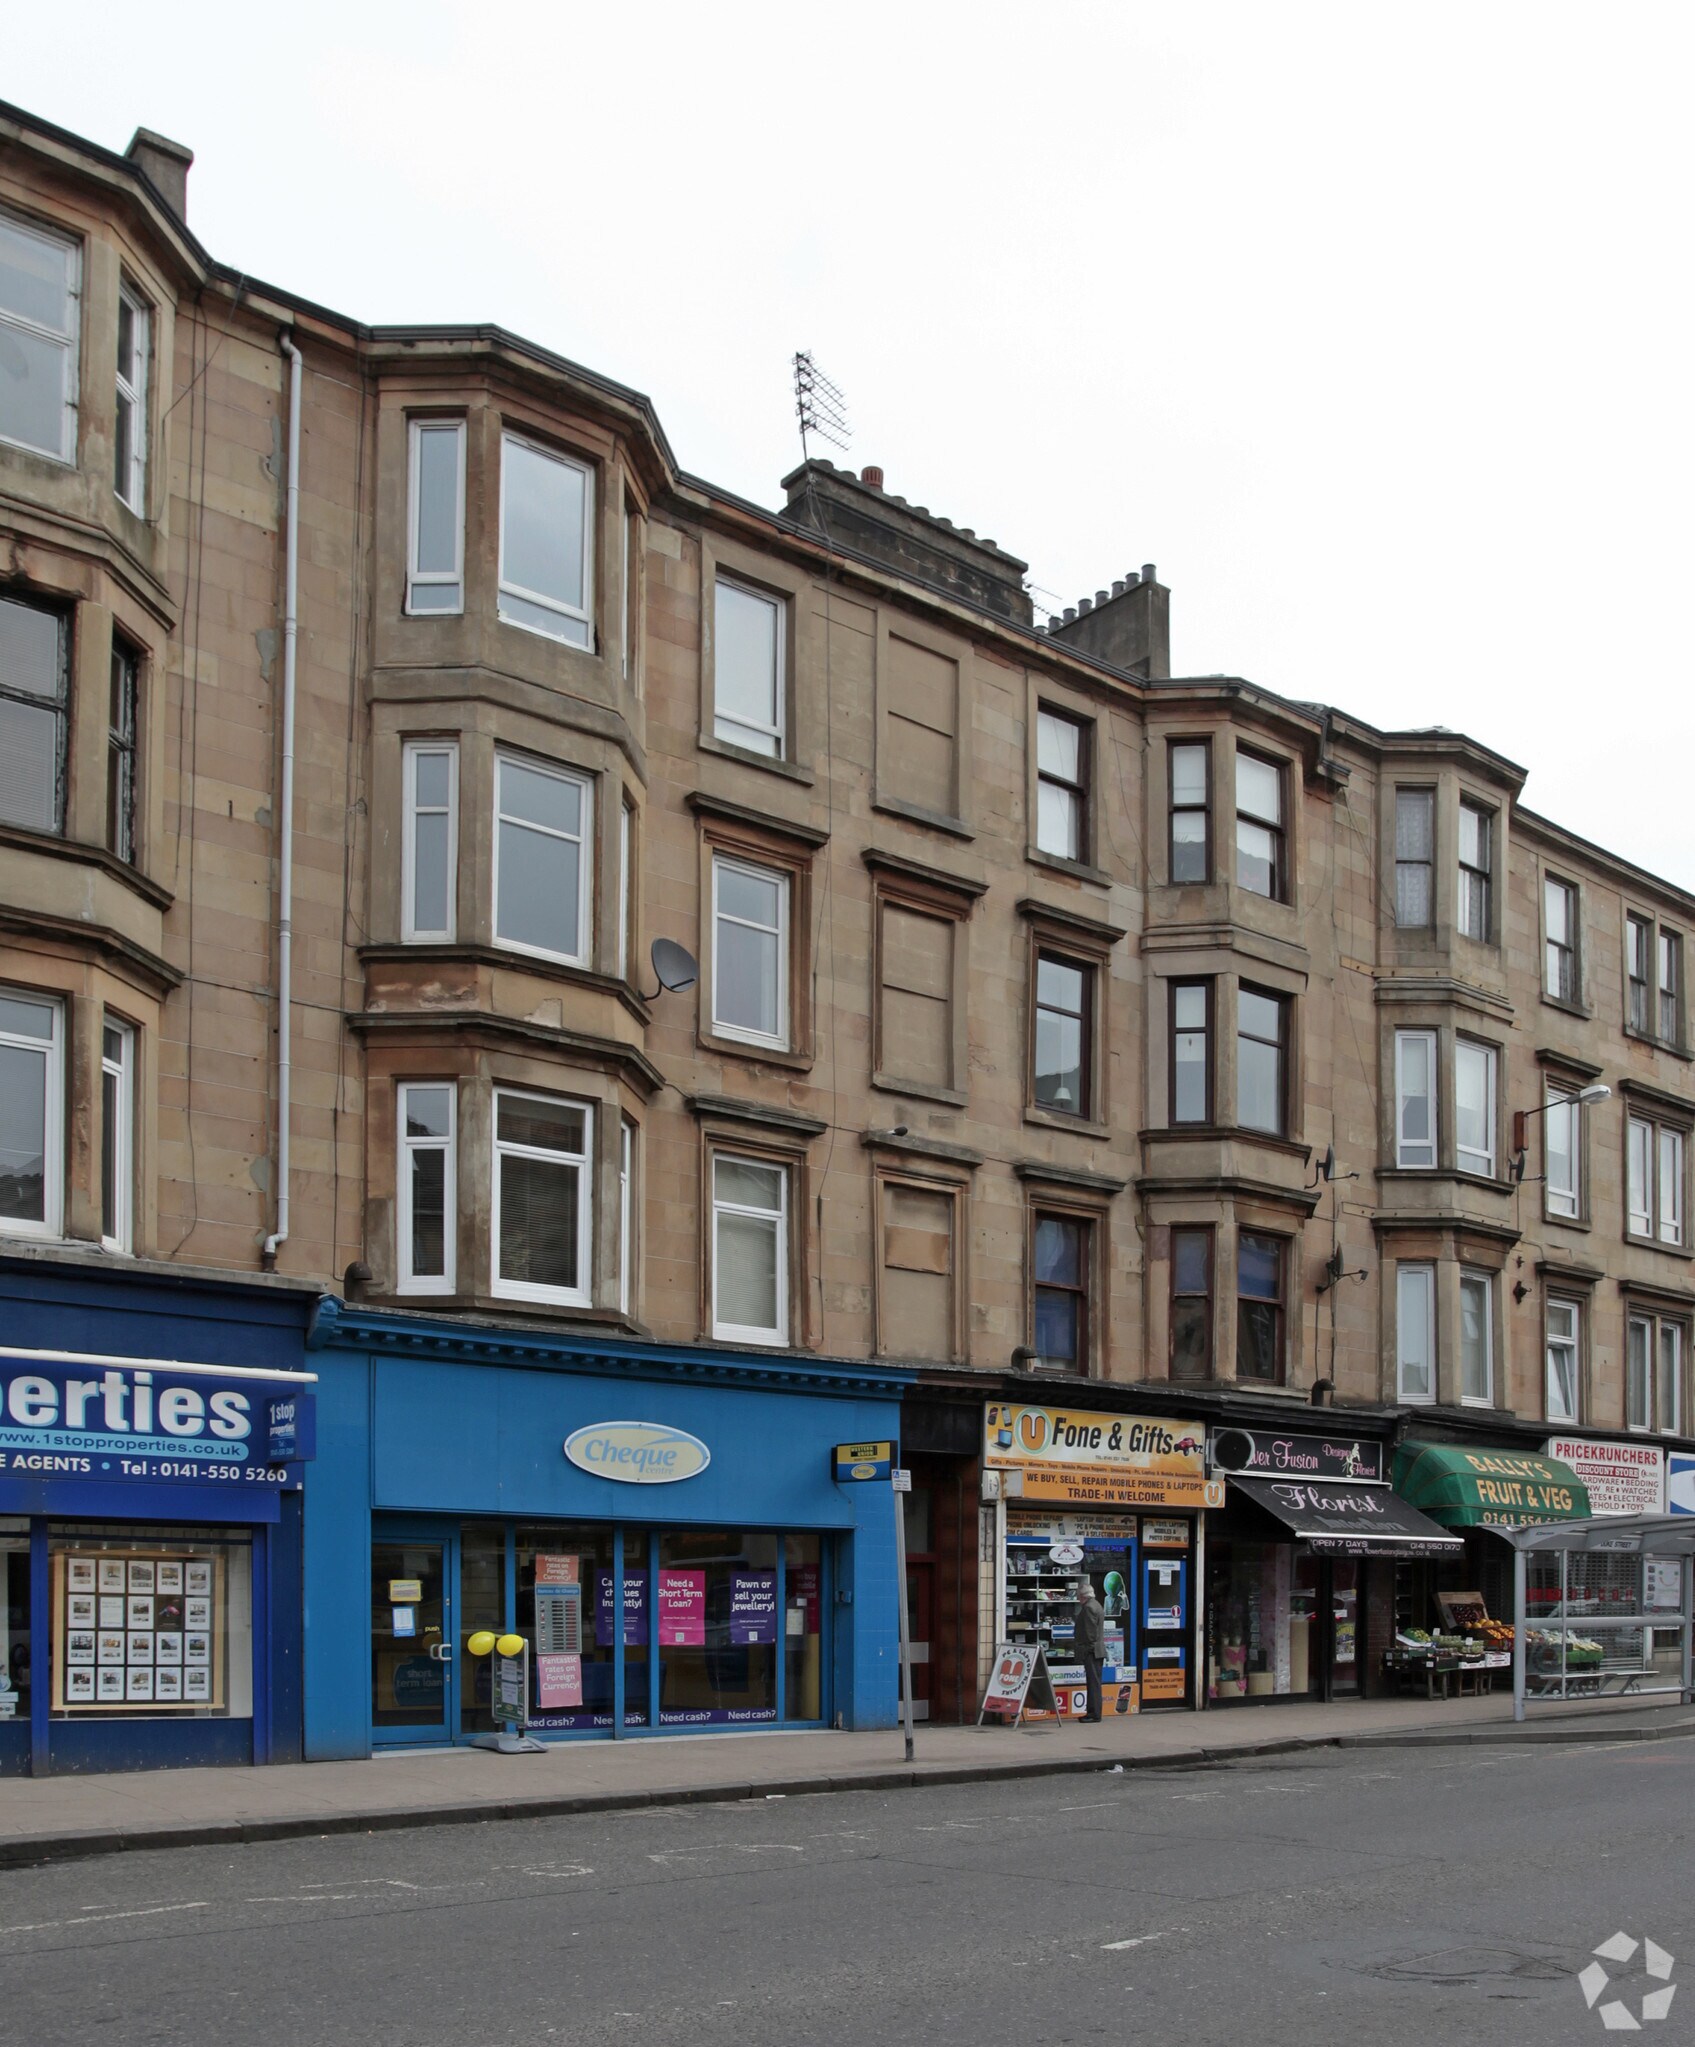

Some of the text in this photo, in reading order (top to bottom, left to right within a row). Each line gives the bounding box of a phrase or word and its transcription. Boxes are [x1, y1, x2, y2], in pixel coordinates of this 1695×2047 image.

[0, 1371, 252, 1439] erties
[276, 1403, 295, 1421] stop
[1052, 1416, 1102, 1449] Fone
[1108, 1421, 1122, 1451] &
[1129, 1423, 1173, 1455] Gifts
[0, 1433, 241, 1456] ww.1stopproperties.co.uk
[584, 1439, 677, 1472] Cheque
[1272, 1440, 1319, 1469] Fusion
[1556, 1443, 1658, 1466] PRICEKRUNCHERS
[12, 1454, 91, 1472] AGENTS
[246, 1468, 287, 1482] 5260
[1465, 1454, 1553, 1480] BALLY'S
[1577, 1464, 1614, 1476] DISCOUNT
[1615, 1466, 1639, 1477] STORE
[1027, 1473, 1039, 1482] WE
[1082, 1476, 1108, 1487] REPAIR
[1110, 1478, 1136, 1488] MOBILE
[1138, 1480, 1164, 1490] PHONES
[1173, 1481, 1203, 1492] LAPTOPS
[1625, 1479, 1659, 1488] BEDDING
[1068, 1487, 1165, 1502] TRADE-IN WELCOME
[1476, 1479, 1573, 1511] FRUIT & VEG
[1621, 1487, 1657, 1496] WATCHES
[1271, 1484, 1384, 1513] Florist
[1613, 1494, 1657, 1504] ELECTRICAL
[1626, 1503, 1645, 1511] TOYS
[1346, 1540, 1368, 1548] DAYS
[601, 1578, 643, 1588] Ca your
[666, 1579, 688, 1587] Need
[736, 1579, 772, 1589] Pawn or
[605, 1589, 639, 1597] chues
[658, 1589, 703, 1598] Short Term
[734, 1591, 773, 1602] sell your
[668, 1599, 693, 1608] Loan?
[731, 1601, 775, 1612] jewellery!
[541, 1656, 577, 1665] Fantastic
[407, 1669, 432, 1678] short
[545, 1665, 564, 1673] rates
[546, 1673, 576, 1683] Foreign
[542, 1681, 580, 1691] Currency!
[660, 1711, 711, 1722] Need cash?
[728, 1709, 776, 1720] Need cash?
[528, 1717, 575, 1727] eed cash?
[593, 1716, 614, 1725] Nee
